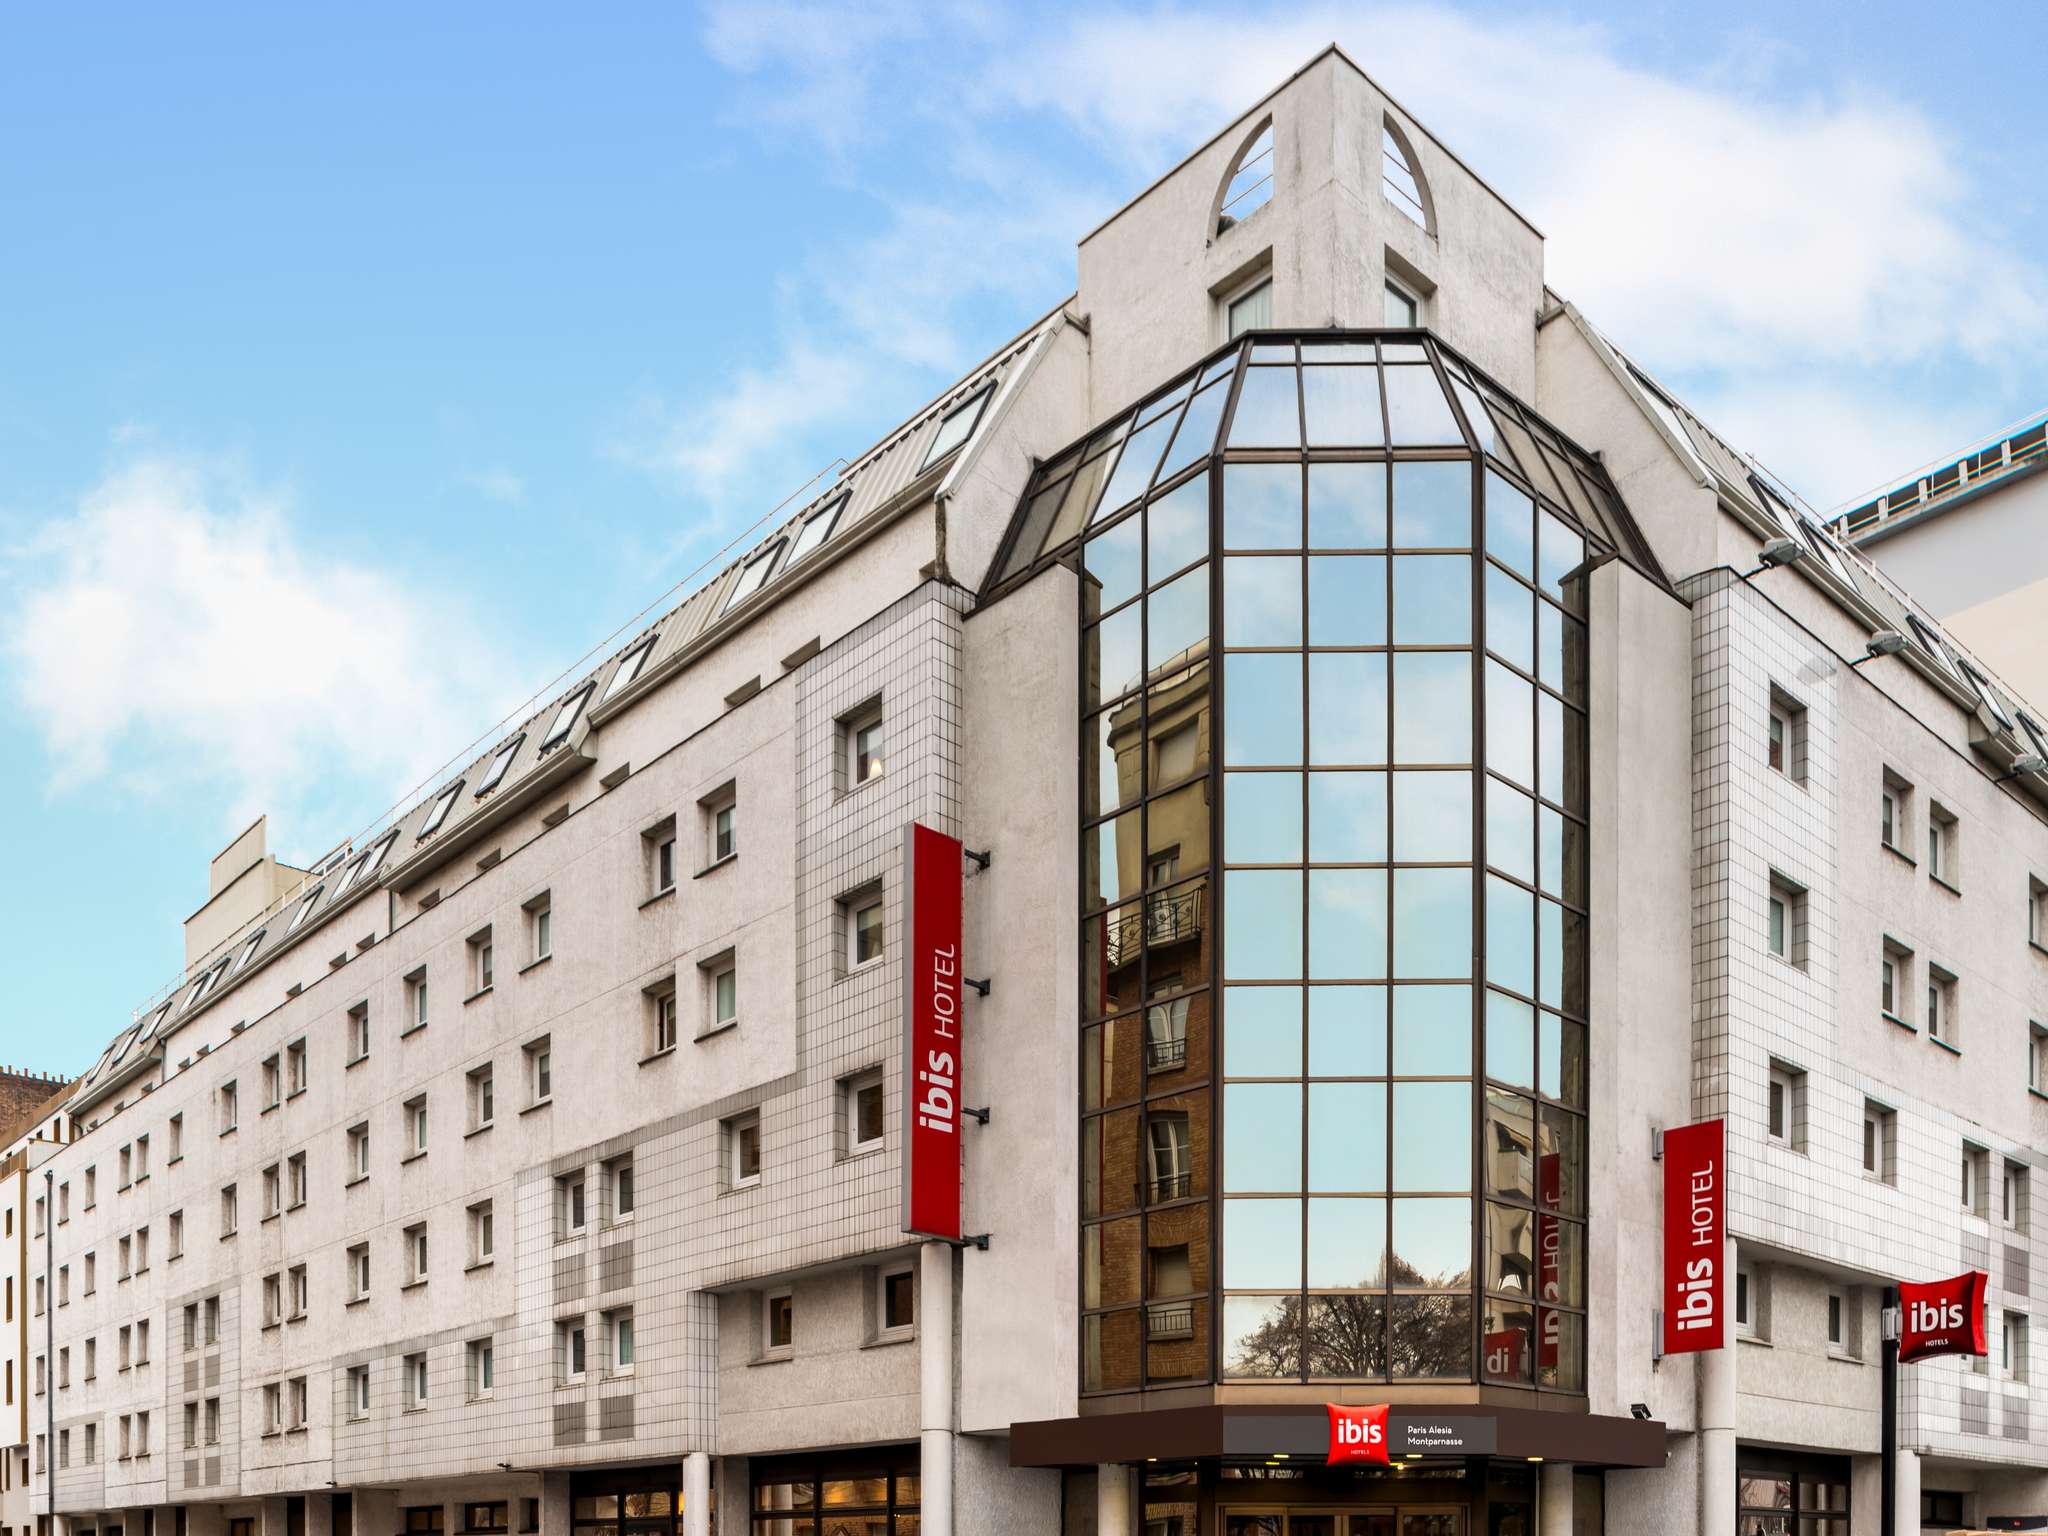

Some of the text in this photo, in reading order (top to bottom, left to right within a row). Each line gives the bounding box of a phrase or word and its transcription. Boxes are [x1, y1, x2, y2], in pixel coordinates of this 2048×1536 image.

[920, 944, 954, 1133] ibis HOTEL
[1677, 1160, 1713, 1331] ibis HOTEL
[1911, 1298, 1964, 1333] ibis
[1925, 1338, 1949, 1347] HOTELS
[1338, 1418, 1382, 1444] ibis
[1407, 1425, 1452, 1434] Paris Alesia
[1407, 1437, 1463, 1447] Montparnasse
